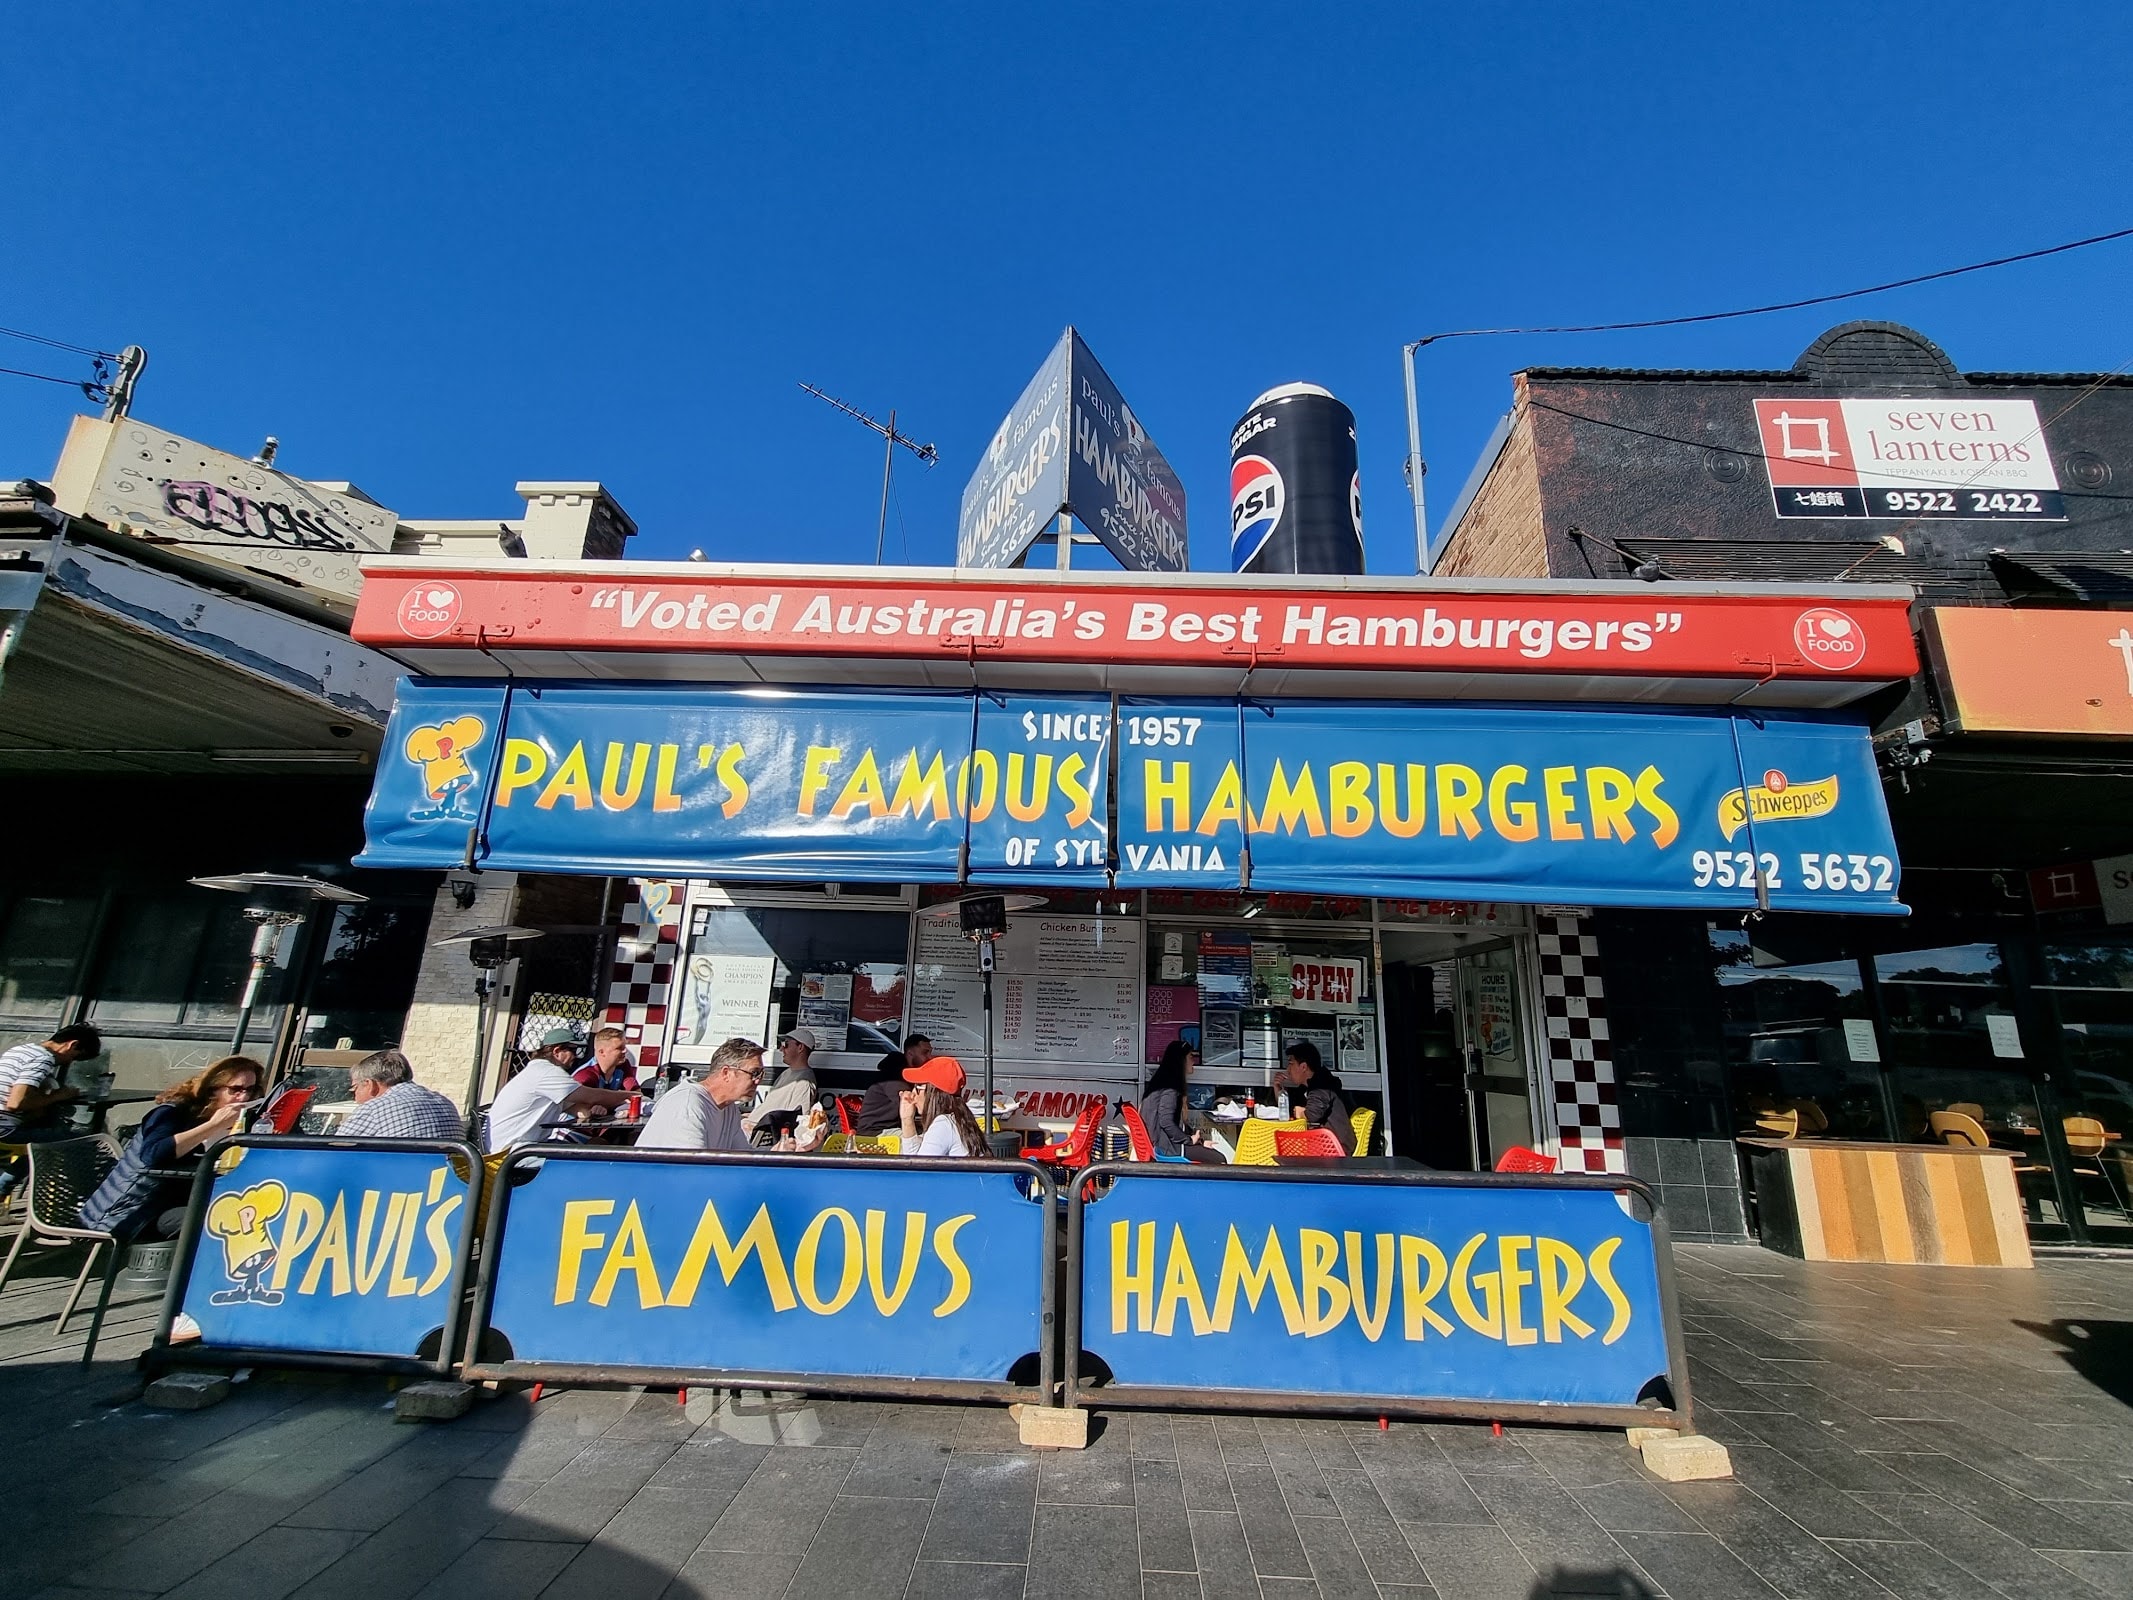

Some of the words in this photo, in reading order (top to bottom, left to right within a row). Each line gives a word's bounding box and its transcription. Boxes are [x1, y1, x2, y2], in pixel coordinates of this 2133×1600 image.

[1013, 375, 1059, 449] famous
[1231, 412, 1262, 446] ASTE
[1887, 407, 1998, 432] seven
[1081, 375, 1121, 438] paul's
[1147, 460, 1182, 522] famous
[1867, 430, 2031, 464] lanterns
[958, 405, 1061, 568] HAMBURGERS
[1075, 403, 1185, 572] HAMBURGERS
[1885, 468, 1948, 477] TEPPANYAKI
[1960, 468, 2004, 477] KOREAN
[2006, 469, 2029, 478] BBQ
[1233, 485, 1275, 532] PSI
[1885, 491, 1957, 511] 9522
[1972, 493, 2043, 513] 2422
[1001, 509, 1036, 561] 5632
[1100, 507, 1137, 557] 9522
[1140, 551, 1163, 571] 56
[1114, 503, 1138, 536] Since
[1140, 530, 1160, 562] 1957
[407, 609, 450, 623] FOOD
[1126, 602, 1261, 644] Best
[1808, 639, 1855, 653] FOOD
[1023, 711, 1102, 742] SINCE
[1128, 716, 1202, 747] 1957
[494, 738, 751, 820] PAUL'S
[796, 743, 1095, 830] FAMOUS
[1143, 757, 1680, 849] HAMBURGERS
[1731, 787, 1828, 824] Schweppes
[1005, 838, 1041, 867] OF
[1691, 851, 1781, 889] 9522
[1800, 853, 1894, 893] 5632
[922, 919, 961, 928] Traditio
[1040, 922, 1077, 932] Chicken
[1080, 923, 1117, 934] Burers
[724, 972, 763, 980] CHAMPION
[1292, 963, 1354, 1003] OPEN
[1481, 975, 1505, 984] HOURS
[722, 999, 760, 1008] WINNER
[1148, 990, 1173, 998] GOOD
[1148, 997, 1173, 1006] FOOD
[1148, 1005, 1173, 1014] GUIDE
[1284, 1029, 1294, 1037] Try
[272, 1167, 464, 1298] PAUL'S
[554, 1198, 977, 1319] FAMOUS
[1110, 1219, 1632, 1346] HAMBURGERS
